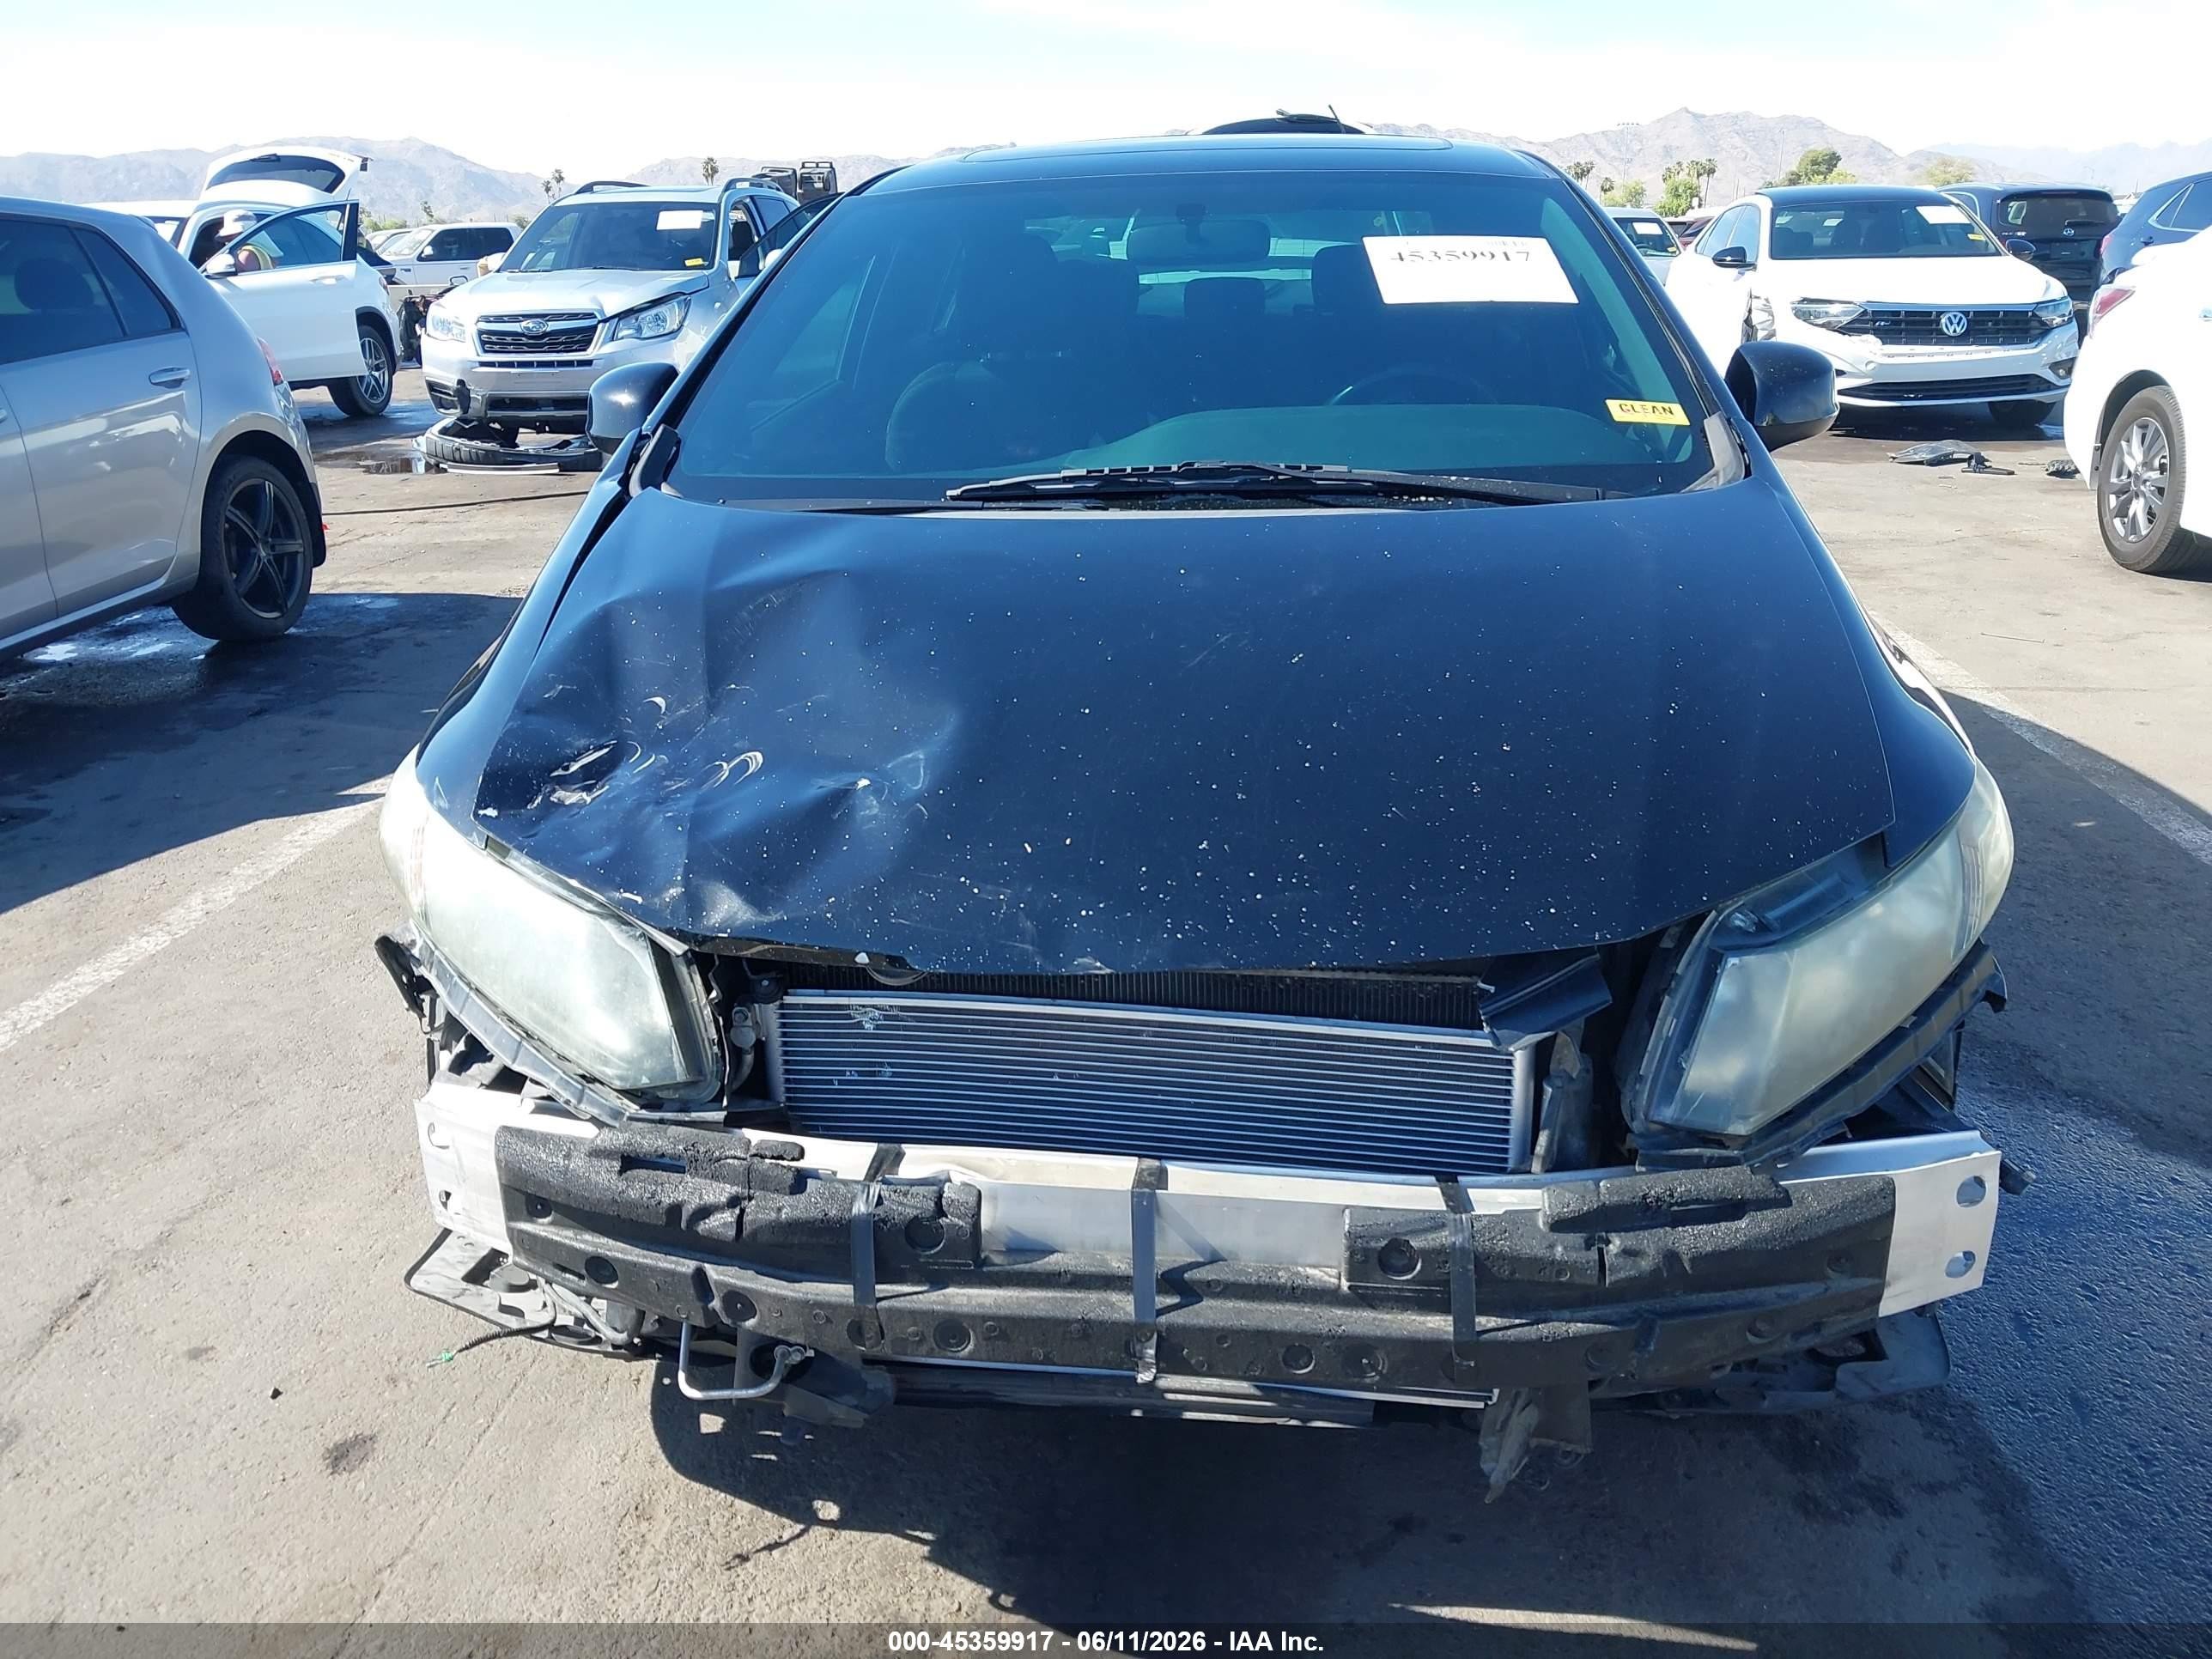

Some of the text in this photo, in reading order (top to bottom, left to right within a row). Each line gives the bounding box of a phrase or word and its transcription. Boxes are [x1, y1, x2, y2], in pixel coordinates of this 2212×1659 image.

[1391, 250, 1530, 262] 45359917
[1942, 312, 1967, 337] VW
[1619, 403, 1674, 416] CLEAN
